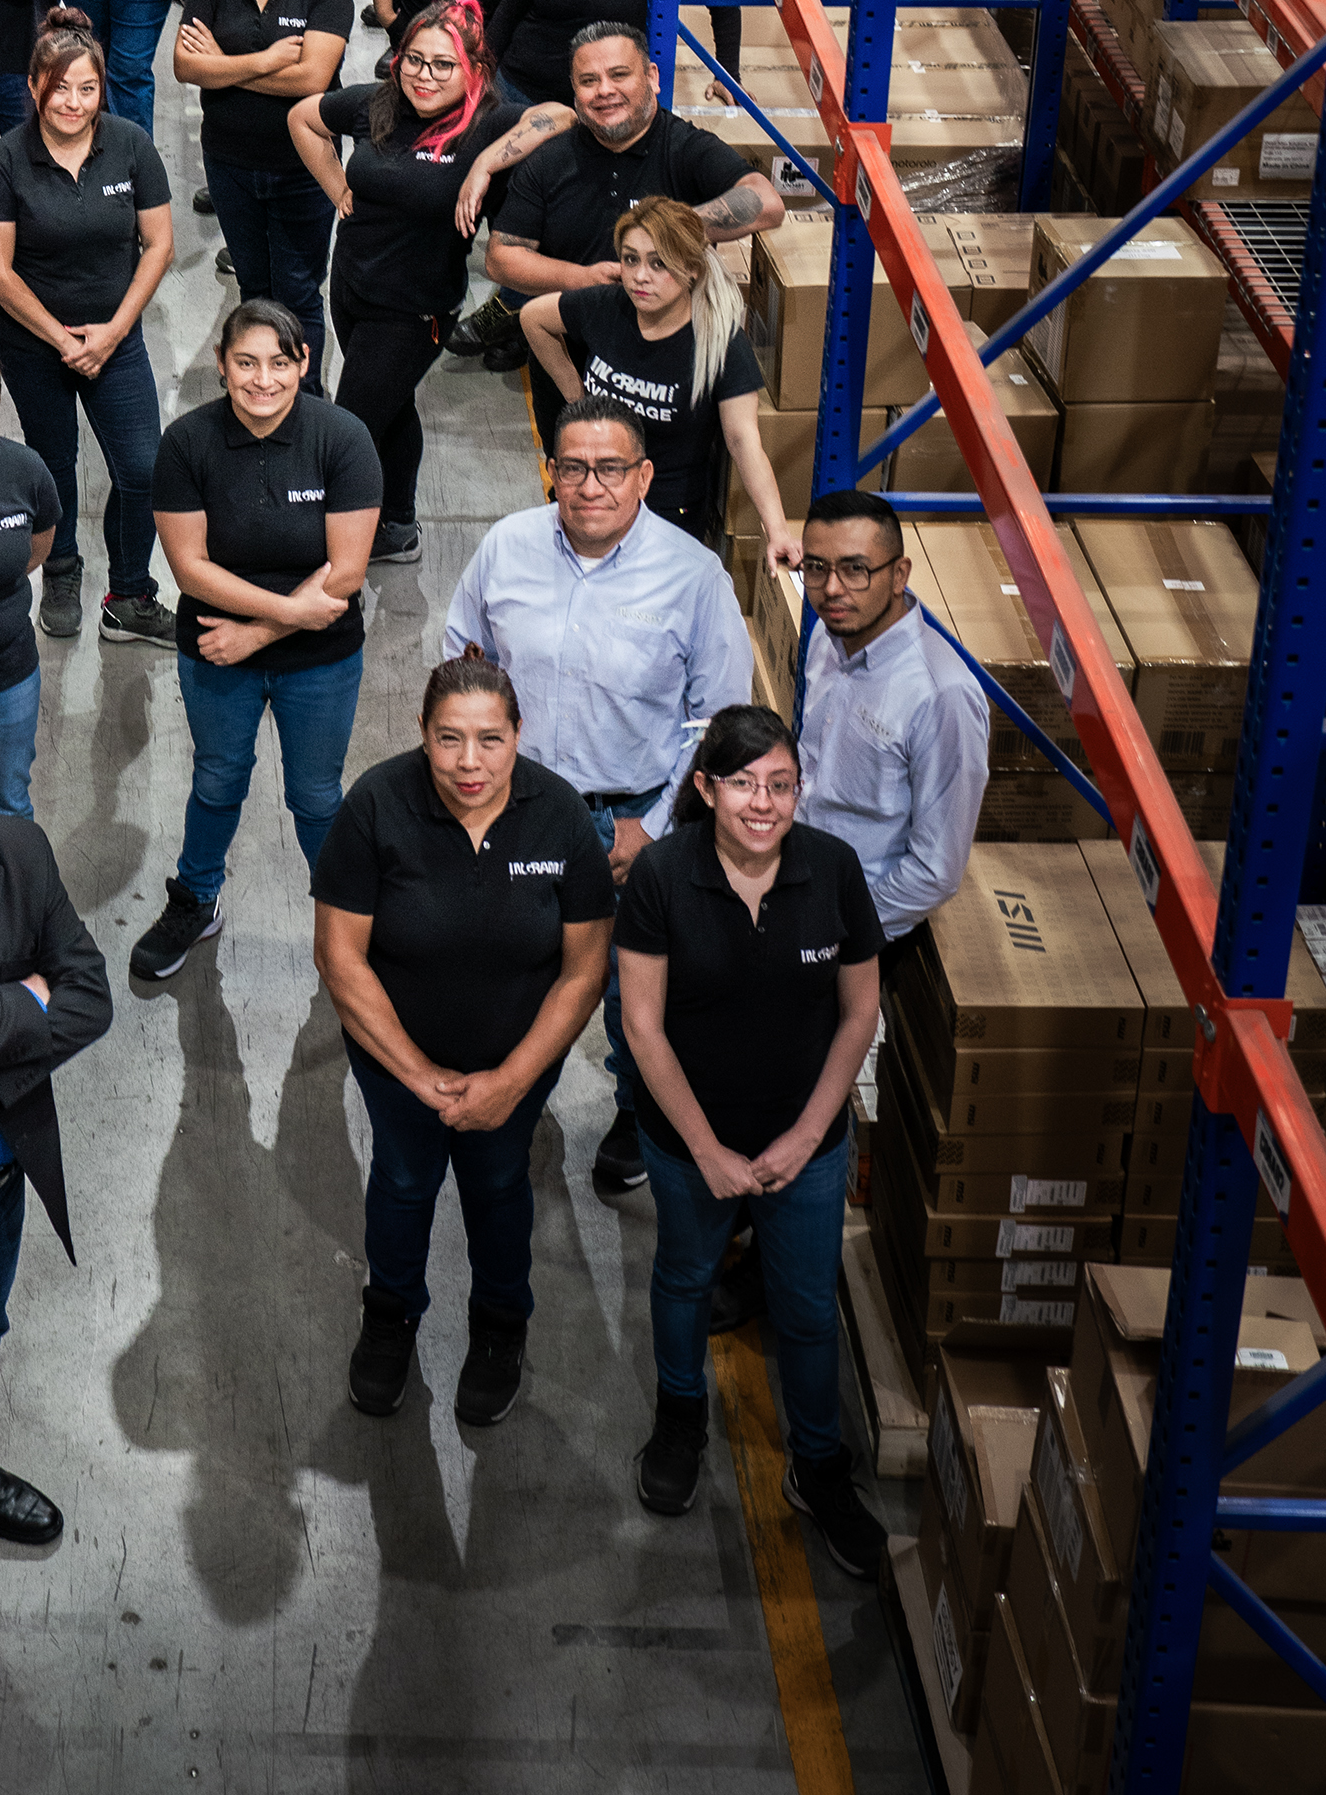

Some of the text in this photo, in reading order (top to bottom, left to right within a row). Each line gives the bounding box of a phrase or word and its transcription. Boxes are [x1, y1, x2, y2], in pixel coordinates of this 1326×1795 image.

[891, 159, 937, 169] motorola
[590, 355, 668, 403] INGRAM
[509, 861, 563, 876] INGRAM
